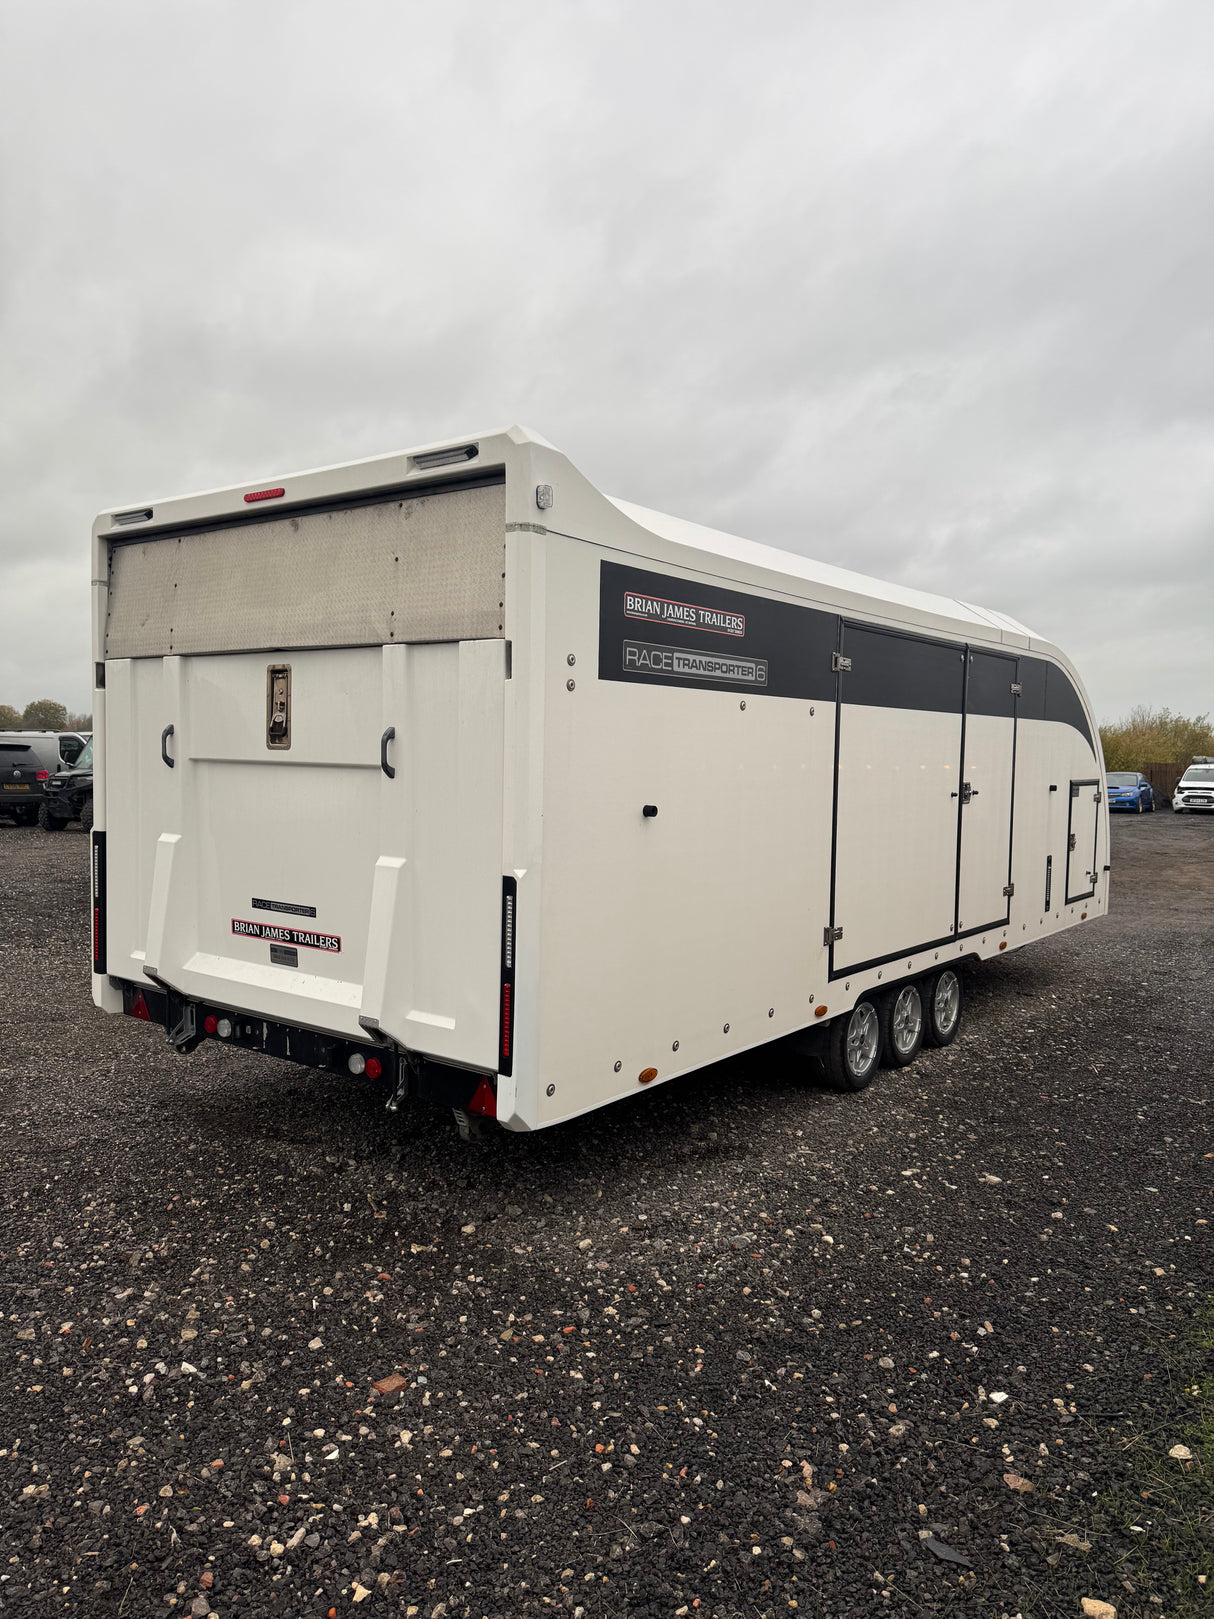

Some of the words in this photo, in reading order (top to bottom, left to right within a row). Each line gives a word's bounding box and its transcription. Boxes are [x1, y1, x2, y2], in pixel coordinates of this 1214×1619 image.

[626, 596, 661, 615] BRIAN
[662, 603, 696, 621] JAMES
[699, 610, 743, 630] TRAILERS
[626, 647, 673, 670] RACE
[675, 656, 755, 678] TRANSPORTER
[252, 899, 271, 909] RACE
[234, 921, 260, 935] BRIAN
[261, 925, 290, 940] JAMES
[292, 931, 339, 949] TRAILERS
